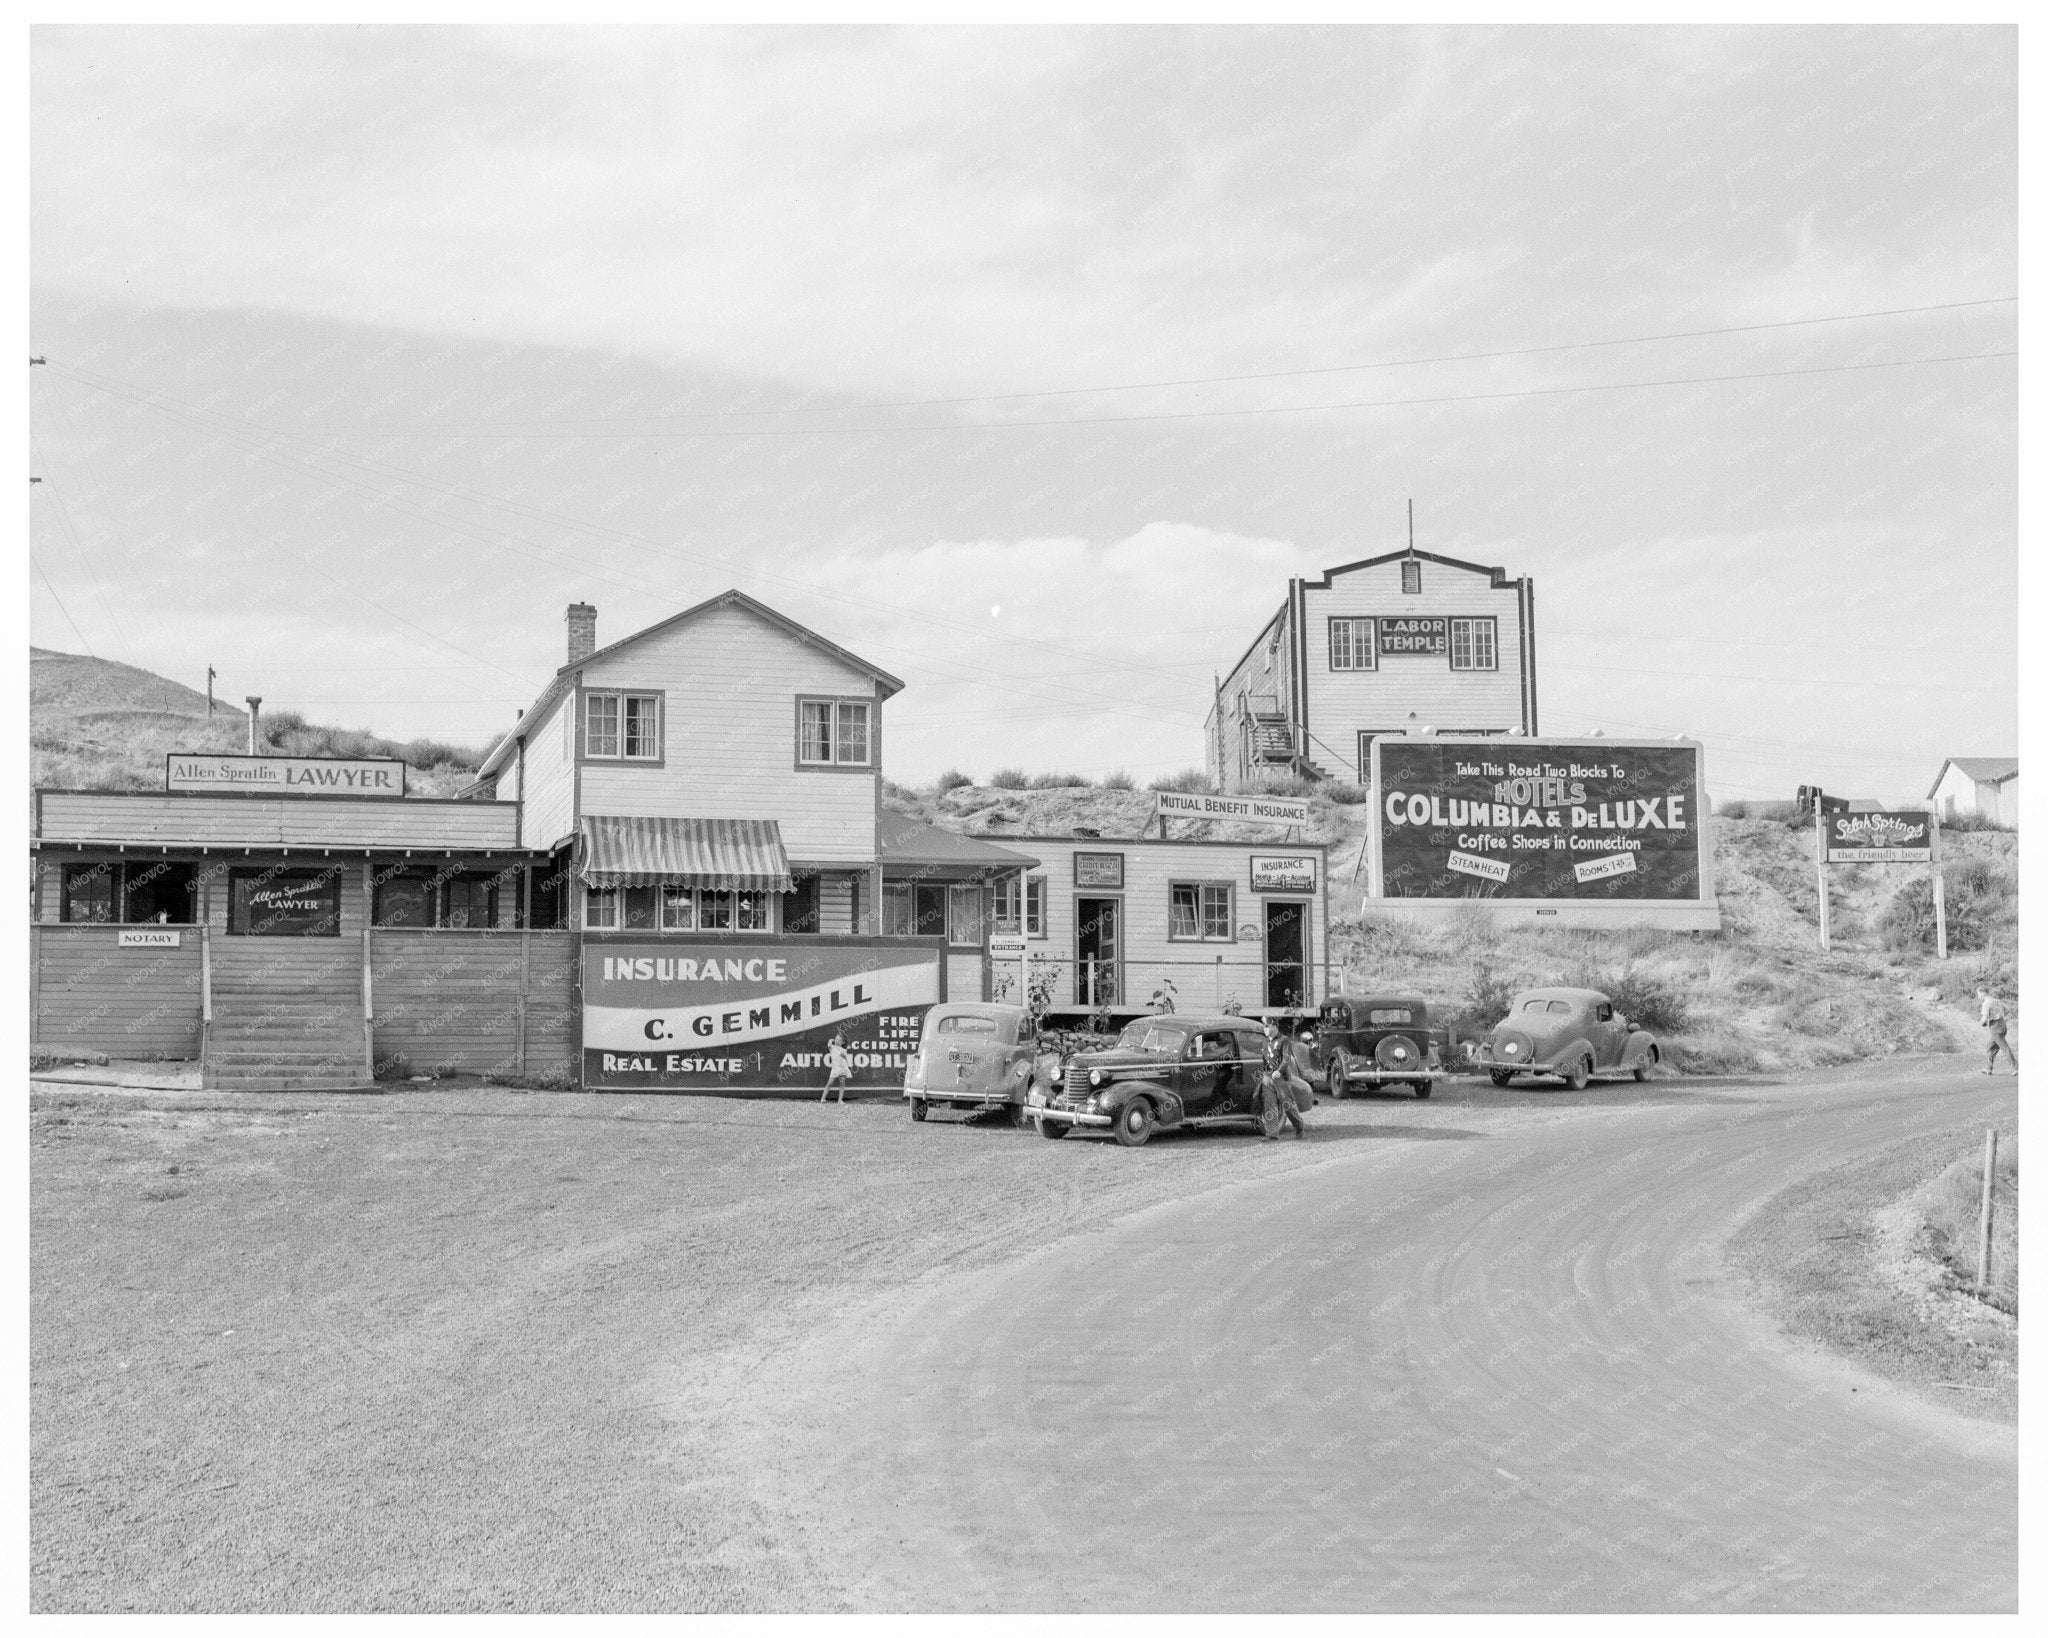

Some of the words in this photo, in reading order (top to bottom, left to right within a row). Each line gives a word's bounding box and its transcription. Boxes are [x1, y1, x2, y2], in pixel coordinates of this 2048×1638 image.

[1382, 620, 1444, 632] LABOR
[1382, 636, 1445, 650] TEMPLE
[174, 764, 215, 779] Allen
[220, 764, 276, 782] Spratlin
[286, 767, 394, 788] LAWYER
[1455, 762, 1481, 776] Take
[1482, 763, 1504, 776] This
[1508, 763, 1541, 777] Road
[1543, 763, 1567, 777] Two
[1570, 764, 1608, 778] Blocks
[1610, 764, 1625, 778] To
[1495, 777, 1587, 807] HOTELS
[1160, 794, 1201, 811] MUTUAL
[1205, 798, 1249, 815] BENEFIT
[1253, 803, 1305, 820] INSURANCE
[1385, 792, 1544, 828] COLUMBIA
[1546, 811, 1562, 827] &
[1835, 813, 1871, 840] Selah
[1871, 813, 1924, 842] Springs
[1458, 833, 1507, 851] Coffee
[1512, 834, 1550, 849] Shops
[1553, 835, 1566, 849] in
[1569, 835, 1641, 850] Connection
[1838, 849, 1854, 859] the
[1858, 849, 1896, 861] friendly
[1901, 849, 1924, 859] beer
[1261, 859, 1304, 871] INSURANCE
[1451, 855, 1480, 871] STEAM
[1481, 861, 1506, 877] HEAT
[1579, 863, 1609, 878] ROOMS
[249, 890, 282, 905] Allen
[284, 882, 322, 899] Spratlin
[267, 900, 319, 910] LAWYER
[124, 935, 173, 943] NOTARY
[604, 957, 787, 982] INSURANCE
[644, 1018, 674, 1040] C.
[692, 984, 872, 1037] GEMMILL
[880, 1016, 919, 1027] FIRE
[880, 1029, 919, 1038] LIFE
[846, 1041, 919, 1050] CCIDENT
